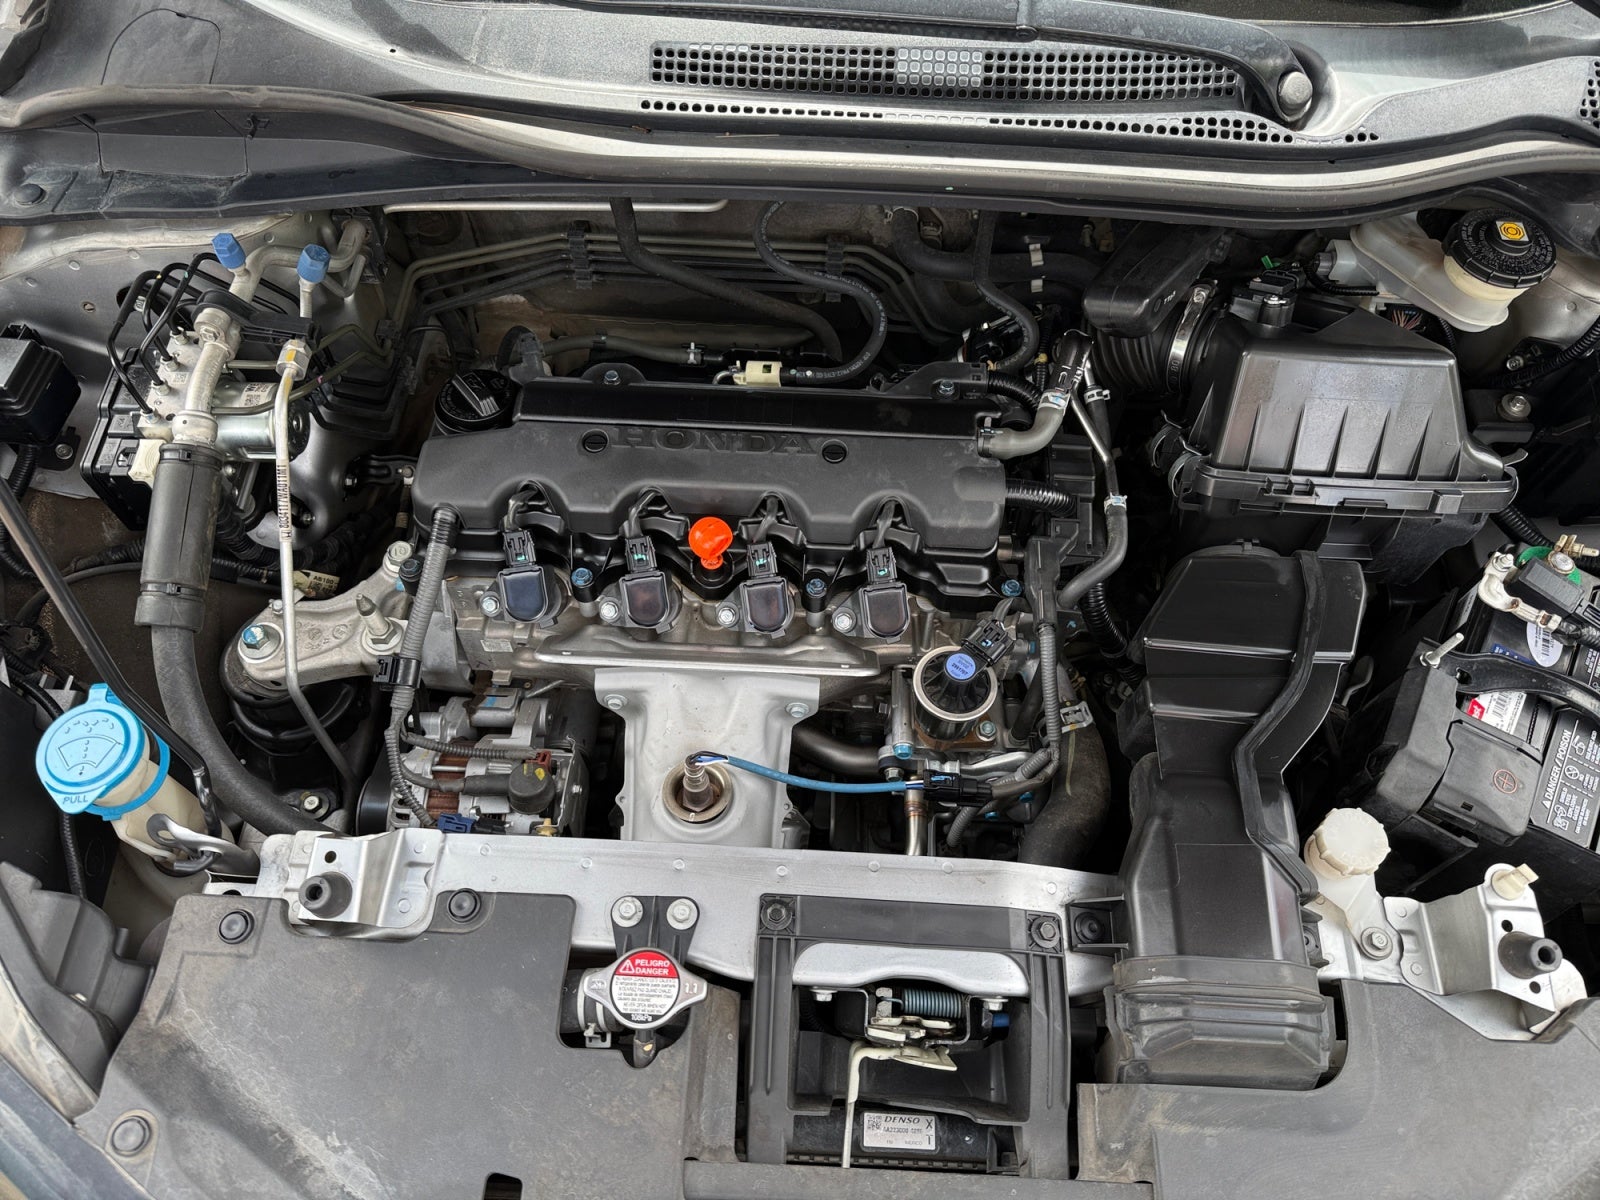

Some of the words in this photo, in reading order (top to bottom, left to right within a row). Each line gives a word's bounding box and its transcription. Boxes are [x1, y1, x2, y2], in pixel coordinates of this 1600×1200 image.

[611, 427, 817, 456] HONDA
[1545, 765, 1561, 800] DANGER
[1559, 729, 1572, 760] POISON
[62, 795, 89, 805] PULL
[635, 959, 670, 967] PELIGRO
[635, 968, 669, 976] DANGER
[685, 983, 698, 994] 1.1
[884, 1115, 921, 1124] DENSO
[925, 1118, 934, 1130] X
[925, 1134, 934, 1145] T
